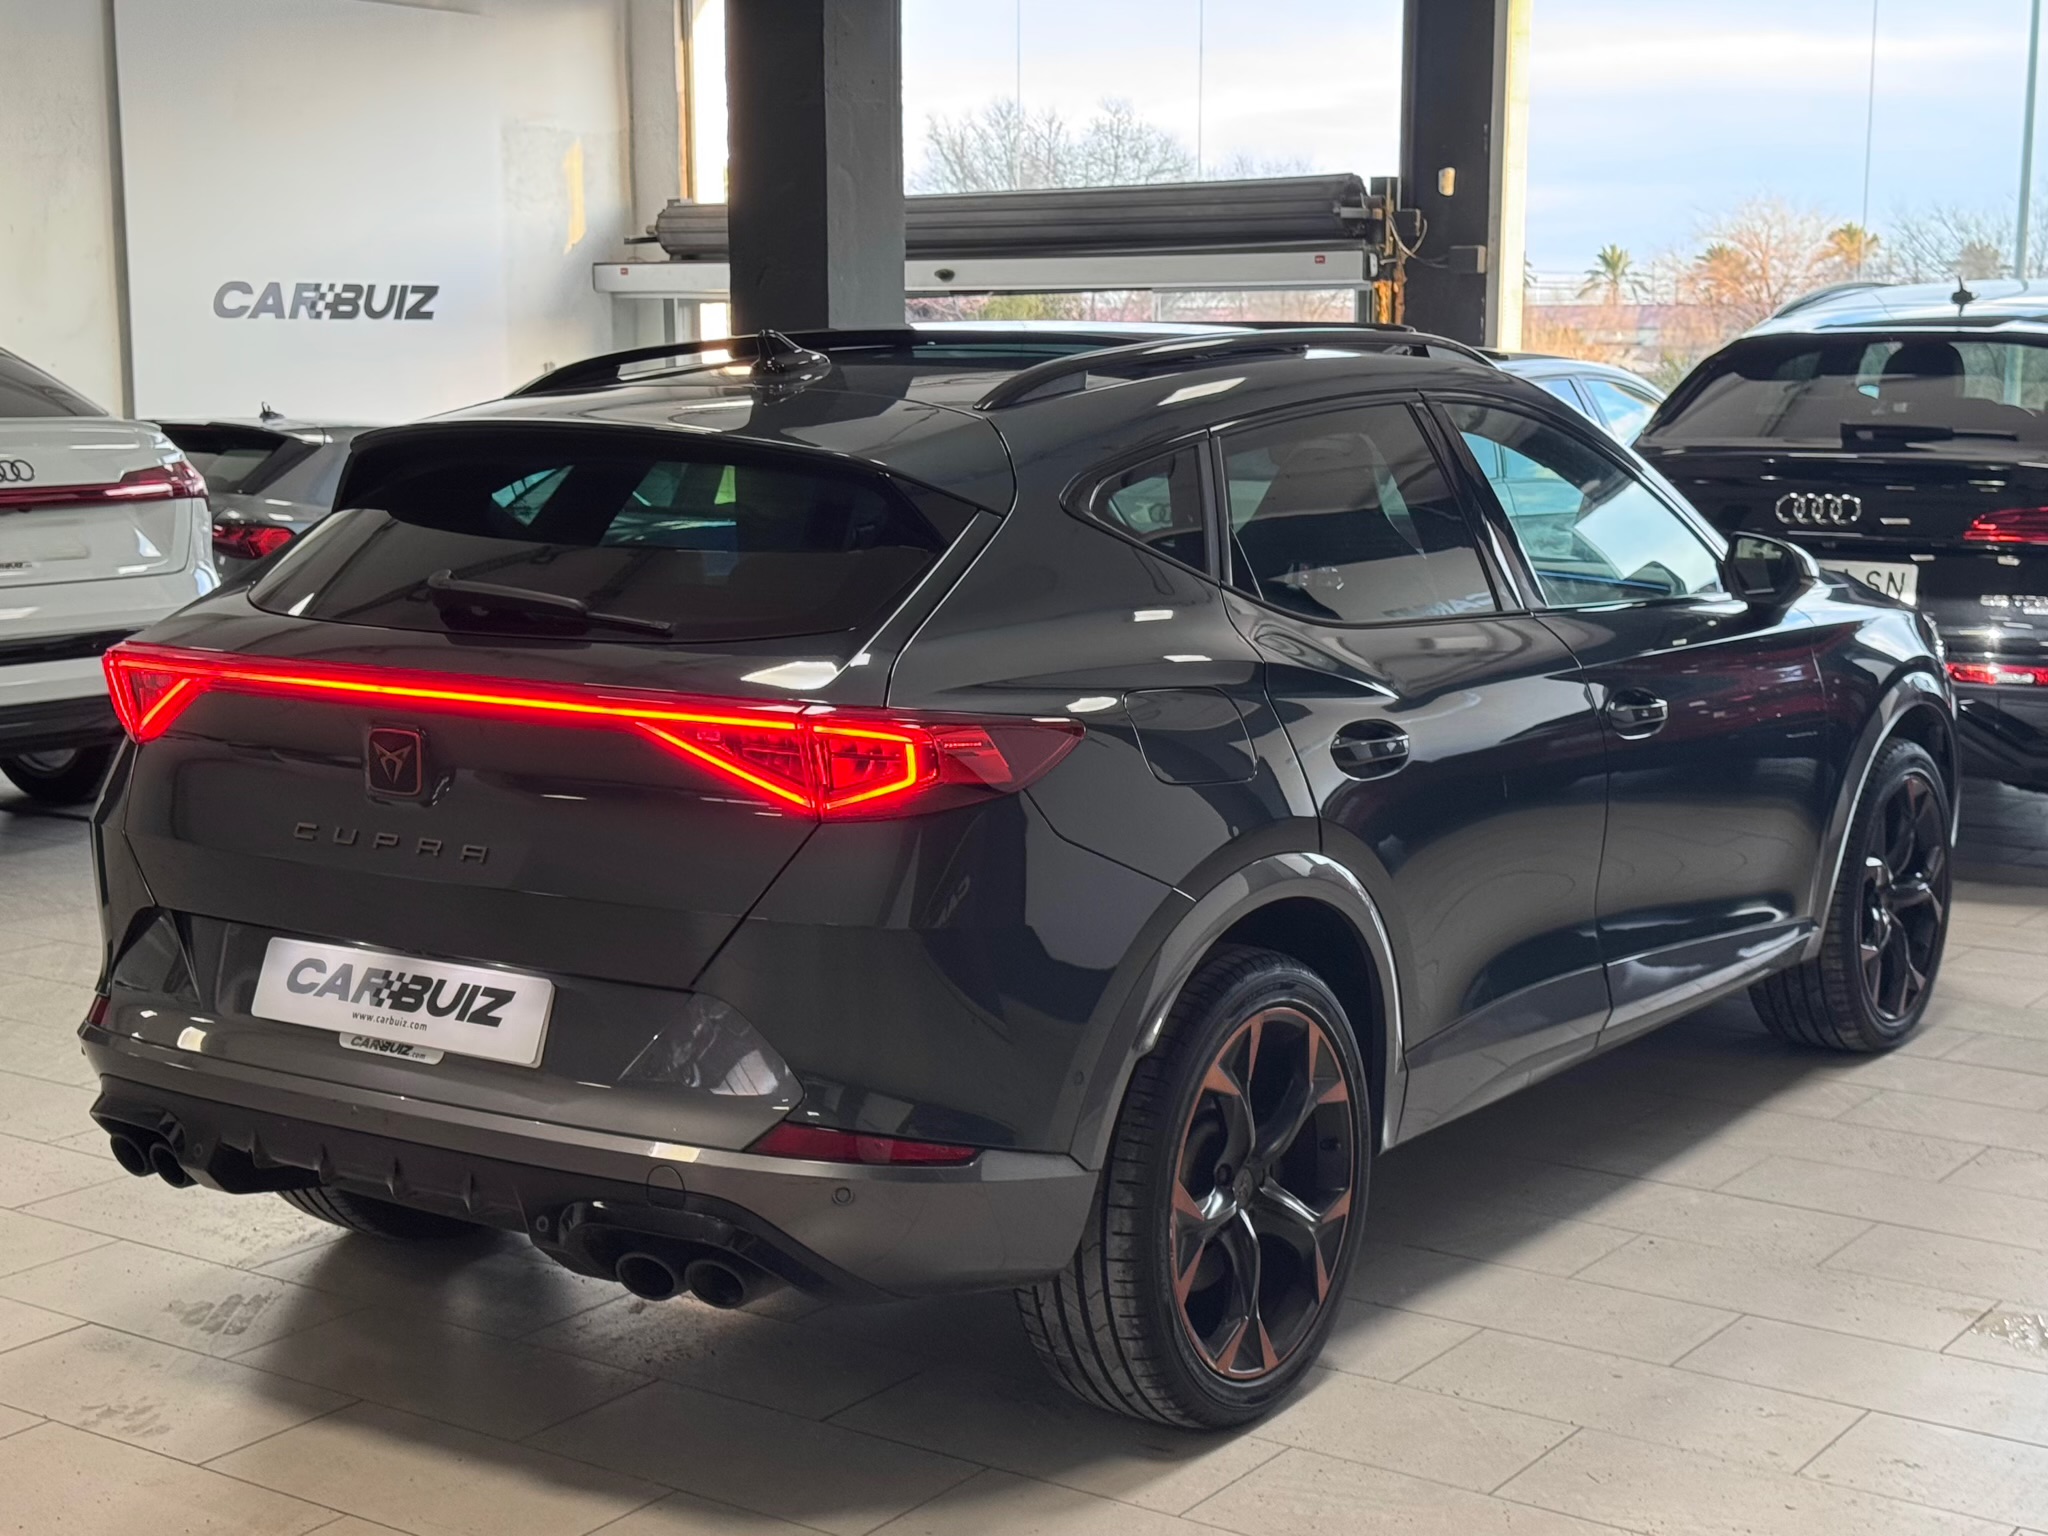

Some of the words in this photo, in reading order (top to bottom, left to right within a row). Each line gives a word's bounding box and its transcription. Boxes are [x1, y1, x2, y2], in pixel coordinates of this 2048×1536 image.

[213, 281, 440, 320] CARBUIZ
[293, 821, 490, 866] CUPRA
[285, 957, 517, 1028] CARBUIZ
[351, 1011, 428, 1032] www.carbuiz.com
